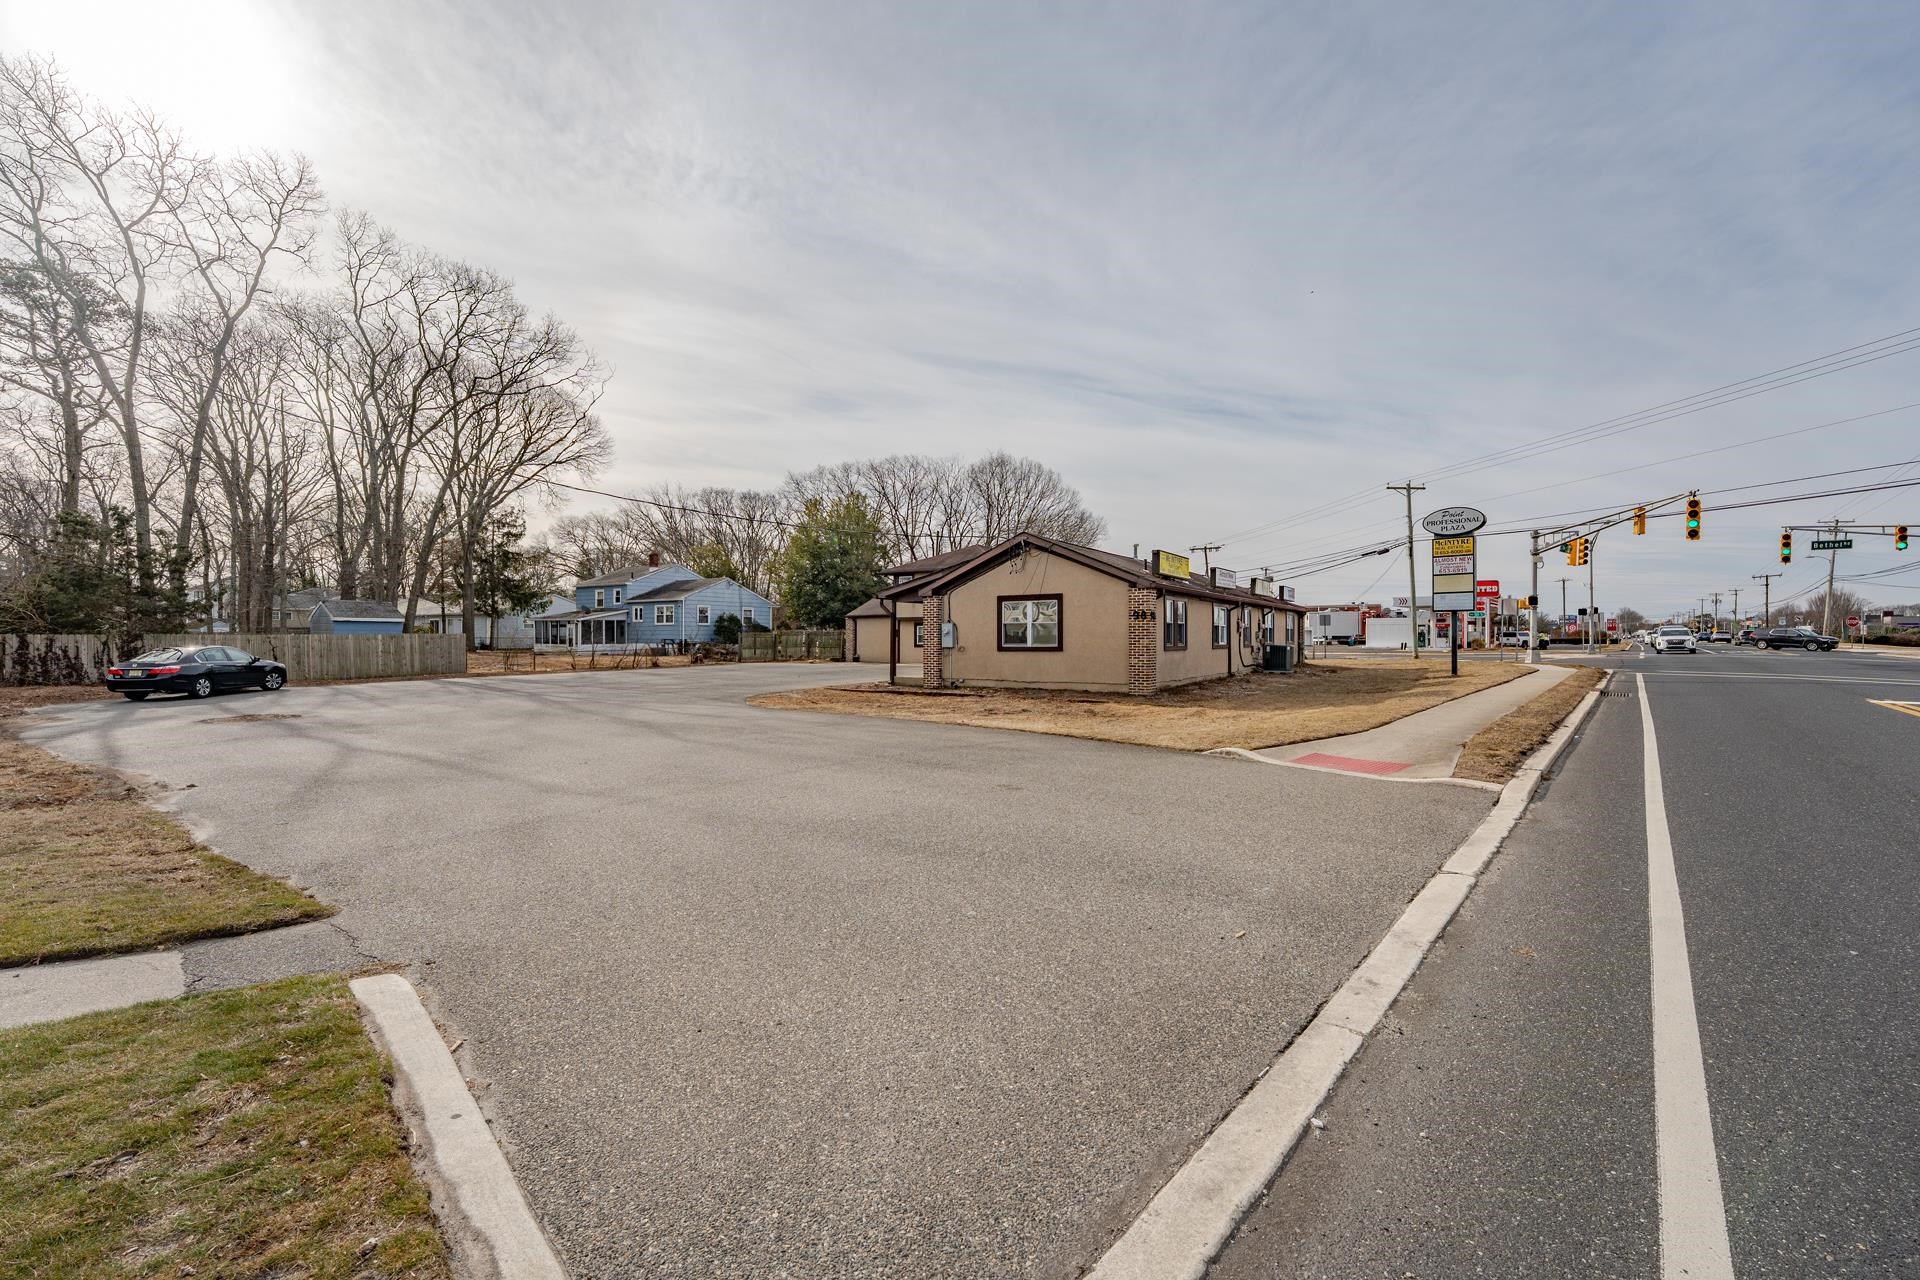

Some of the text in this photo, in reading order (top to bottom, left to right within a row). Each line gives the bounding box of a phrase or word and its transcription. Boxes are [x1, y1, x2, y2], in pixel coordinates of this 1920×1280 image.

[1441, 511, 1465, 519] Point
[1426, 516, 1480, 527] PROFESSIONAL
[1440, 524, 1466, 532] PLAZA
[1435, 538, 1471, 547] McINTYRE
[1813, 541, 1843, 549] Bethel
[1476, 585, 1498, 593] ITED
